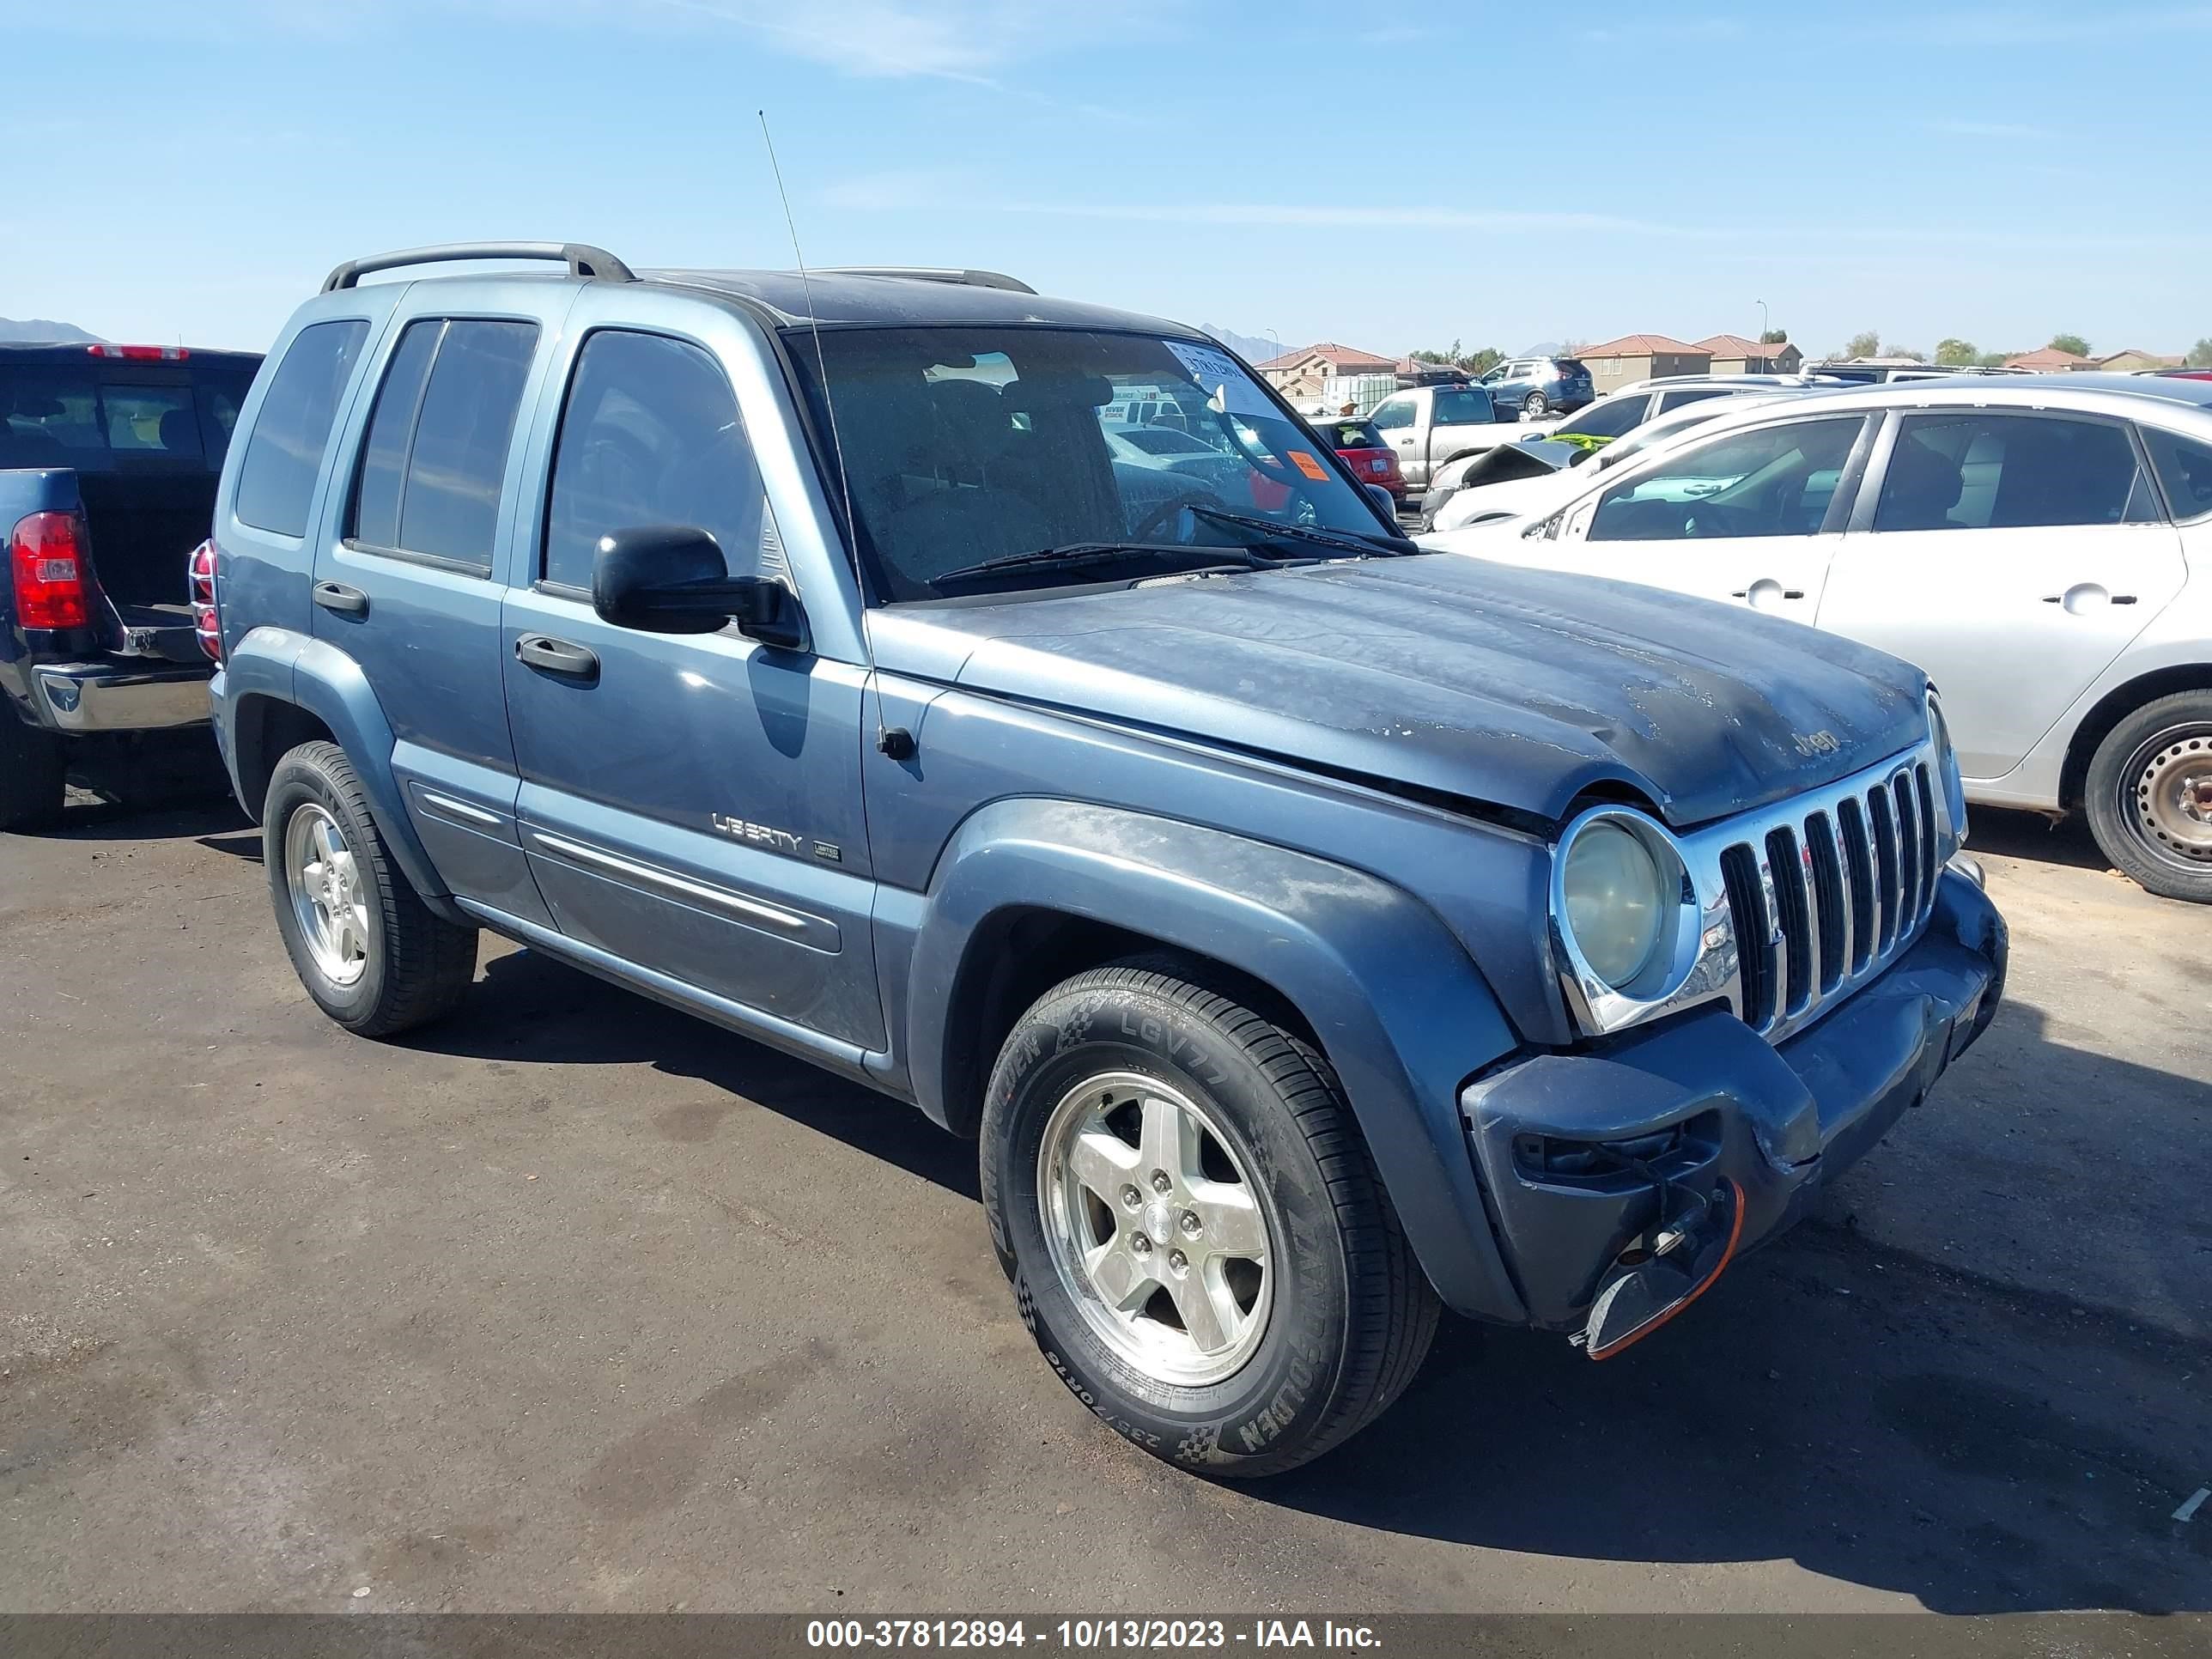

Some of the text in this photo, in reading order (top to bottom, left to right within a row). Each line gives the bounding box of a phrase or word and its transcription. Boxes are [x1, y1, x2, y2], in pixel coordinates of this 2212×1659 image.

[712, 812, 803, 851] LIBERTY
[814, 843, 839, 855] LIMITED
[1121, 1012, 1229, 1085] LGV77
[1043, 1351, 1161, 1449] 235/70R16
